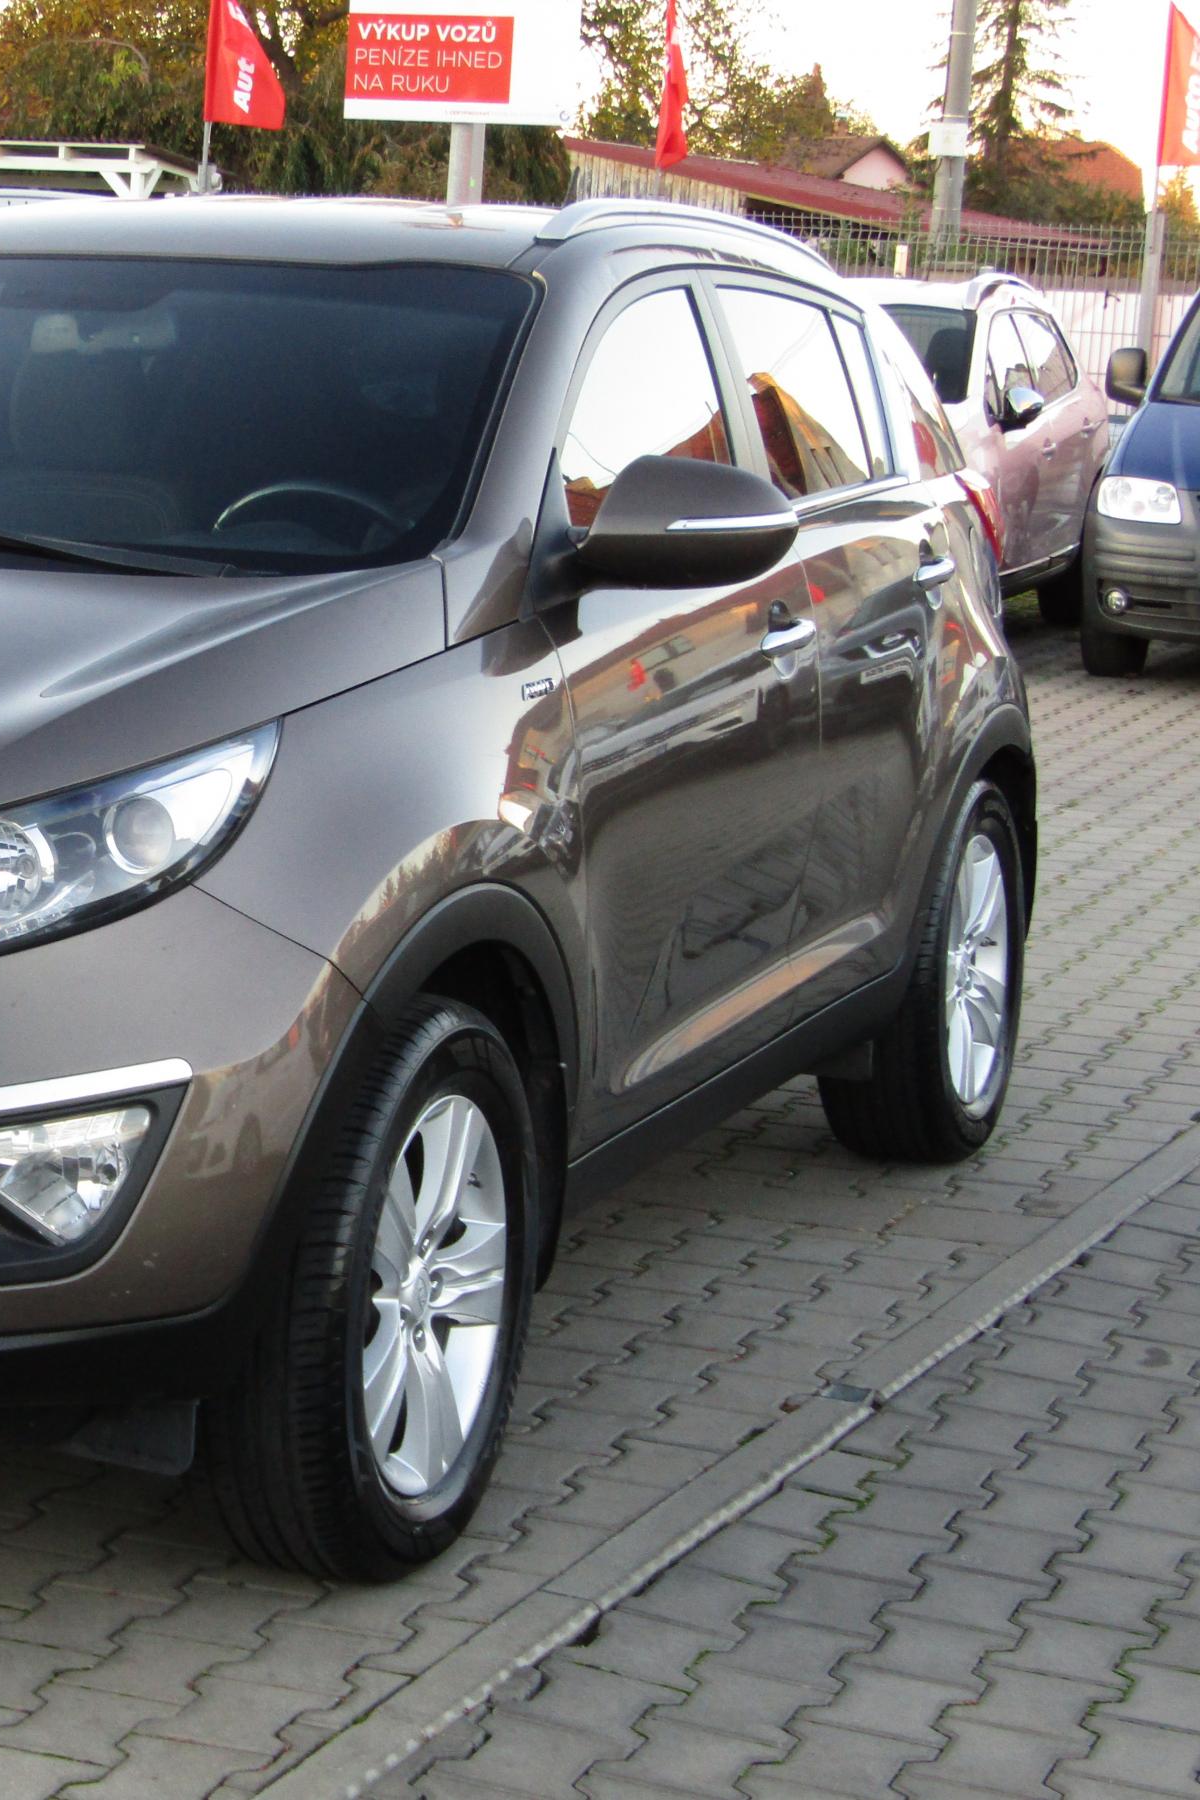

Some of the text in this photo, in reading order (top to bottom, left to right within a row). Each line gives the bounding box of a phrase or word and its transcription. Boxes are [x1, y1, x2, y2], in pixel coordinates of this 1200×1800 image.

[358, 19, 497, 43] VÝKUP VOZŮ
[354, 46, 503, 69] PENÍZE IHNED
[353, 73, 450, 93] NA RUKU
